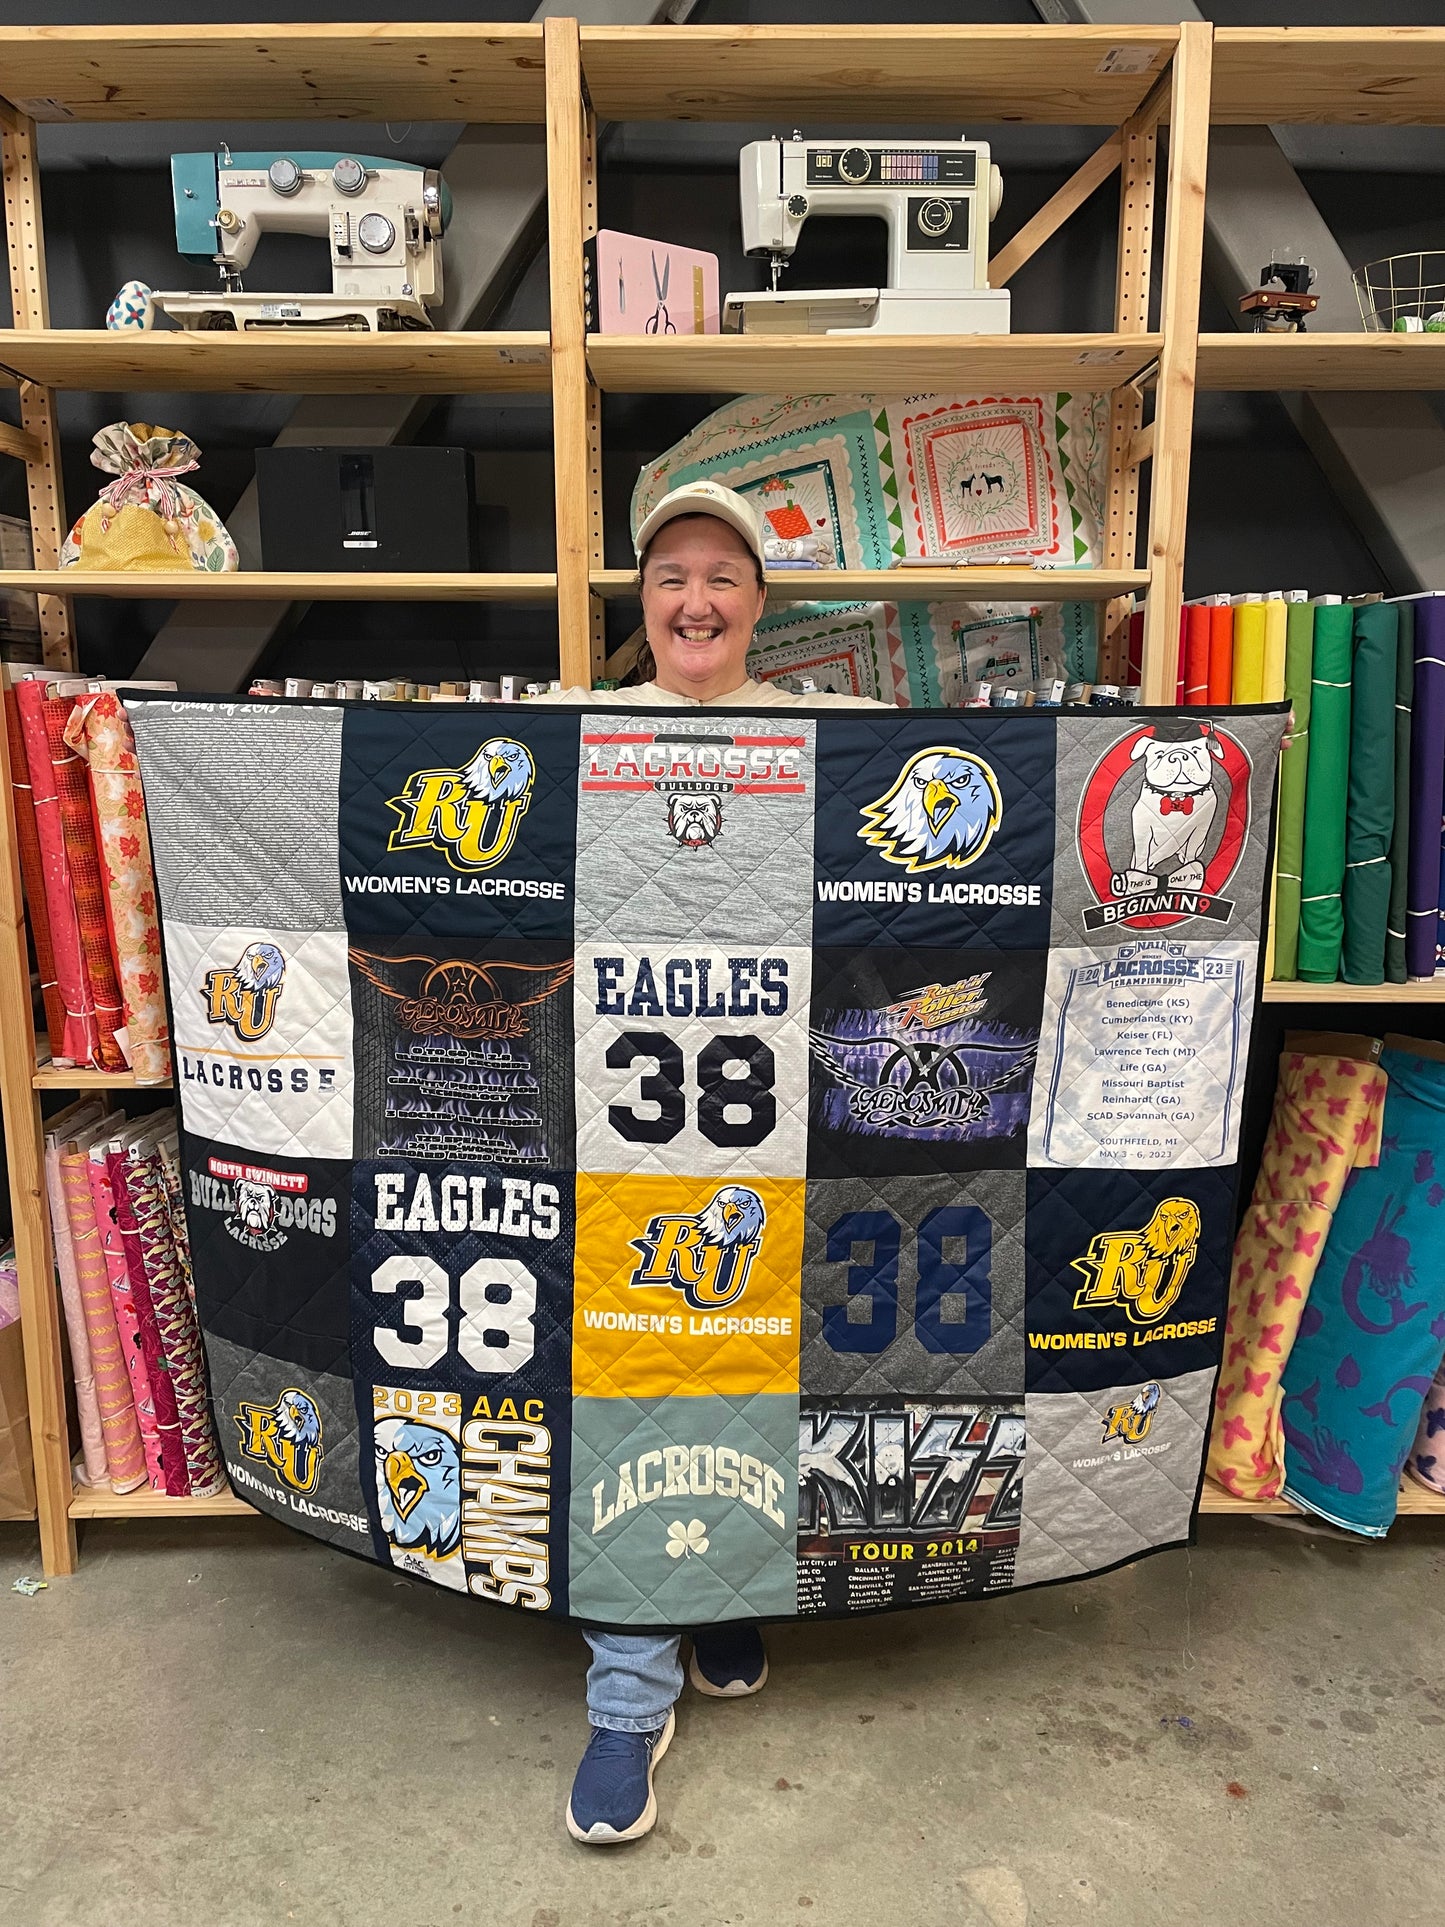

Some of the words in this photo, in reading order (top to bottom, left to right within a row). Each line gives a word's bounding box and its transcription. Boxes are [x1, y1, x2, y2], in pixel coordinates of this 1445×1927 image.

[653, 724, 695, 733] STATE
[704, 726, 772, 734] PLAYOFFS
[588, 746, 800, 780] LACROSSE
[659, 783, 728, 792] BULLDOGS
[386, 769, 531, 872] RU
[345, 876, 450, 894] WOMEN'S
[456, 878, 566, 900] LACROSSE
[1170, 874, 1187, 882] ONLY
[817, 881, 921, 902] WOMEN'S
[928, 883, 1040, 906] LACROSSE
[1137, 941, 1168, 950] NAIA
[1086, 968, 1100, 980] 20
[1103, 959, 1200, 981] LACROSSE
[1206, 962, 1224, 974] 23
[1114, 978, 1183, 986] CHAMPIONSHIP
[594, 958, 788, 1017] EAGLES
[202, 969, 283, 1042] RU
[888, 989, 984, 1028] Roller
[1106, 999, 1163, 1008] Benedictine
[1167, 999, 1190, 1008] (KS)
[1102, 1015, 1166, 1024] Cumberlands
[1170, 1015, 1193, 1024] (KY)
[1117, 1031, 1149, 1039] Keiser
[1152, 1031, 1173, 1040] (FL)
[395, 1053, 466, 1065] BLURRING
[466, 1058, 530, 1070] SECONDS
[424, 1048, 446, 1056] TO
[1094, 1048, 1142, 1056] Lawrence
[1173, 1048, 1196, 1057] (MI)
[182, 1056, 336, 1093] LACROSSE
[1142, 1064, 1167, 1073] (GA)
[388, 1076, 448, 1088] GRAVITY
[450, 1082, 540, 1094] PROPULSION
[420, 1087, 511, 1101] TECHNOLOGY
[606, 1032, 776, 1148] 38
[1148, 1080, 1184, 1088] Baptist
[1156, 1096, 1181, 1105] (GA)
[458, 1115, 542, 1126] INVERSIONS
[1087, 1112, 1113, 1120] SCAD
[1116, 1112, 1167, 1120] Savannah
[1171, 1112, 1195, 1121] (GA)
[1100, 1138, 1162, 1146] SOUTHFIELD,
[378, 1148, 446, 1160] ONBOARD
[448, 1152, 492, 1162] AUDIO
[494, 1156, 550, 1164] SYSTEM
[1136, 1151, 1146, 1159] 6,
[210, 1160, 242, 1177] NORTH
[246, 1168, 305, 1189] GWINNETT
[188, 1169, 236, 1212] BULL
[278, 1196, 337, 1238] DOGS
[374, 1172, 560, 1240] EAGLES
[224, 1216, 288, 1252] LACROSSE
[627, 1213, 762, 1311] RU
[822, 1206, 992, 1354] 38
[1070, 1232, 1197, 1324] RU
[371, 1256, 538, 1373] 38
[584, 1310, 682, 1334] WOMEN'S
[689, 1316, 792, 1336] LACROSSE
[1028, 1332, 1127, 1350] WOMEN'S
[1132, 1317, 1218, 1346] LACROSSE
[373, 1386, 462, 1416] 2023
[472, 1396, 544, 1422] AAC
[1101, 1404, 1157, 1444] RU
[234, 1402, 324, 1496] RU
[1124, 1442, 1172, 1460] LACROSSE
[592, 1444, 785, 1535] LACROSSE
[290, 1494, 370, 1534] LACROSSE
[462, 1418, 552, 1611] CHAMPS
[850, 1542, 914, 1560] TOUR
[926, 1538, 978, 1558] 2014
